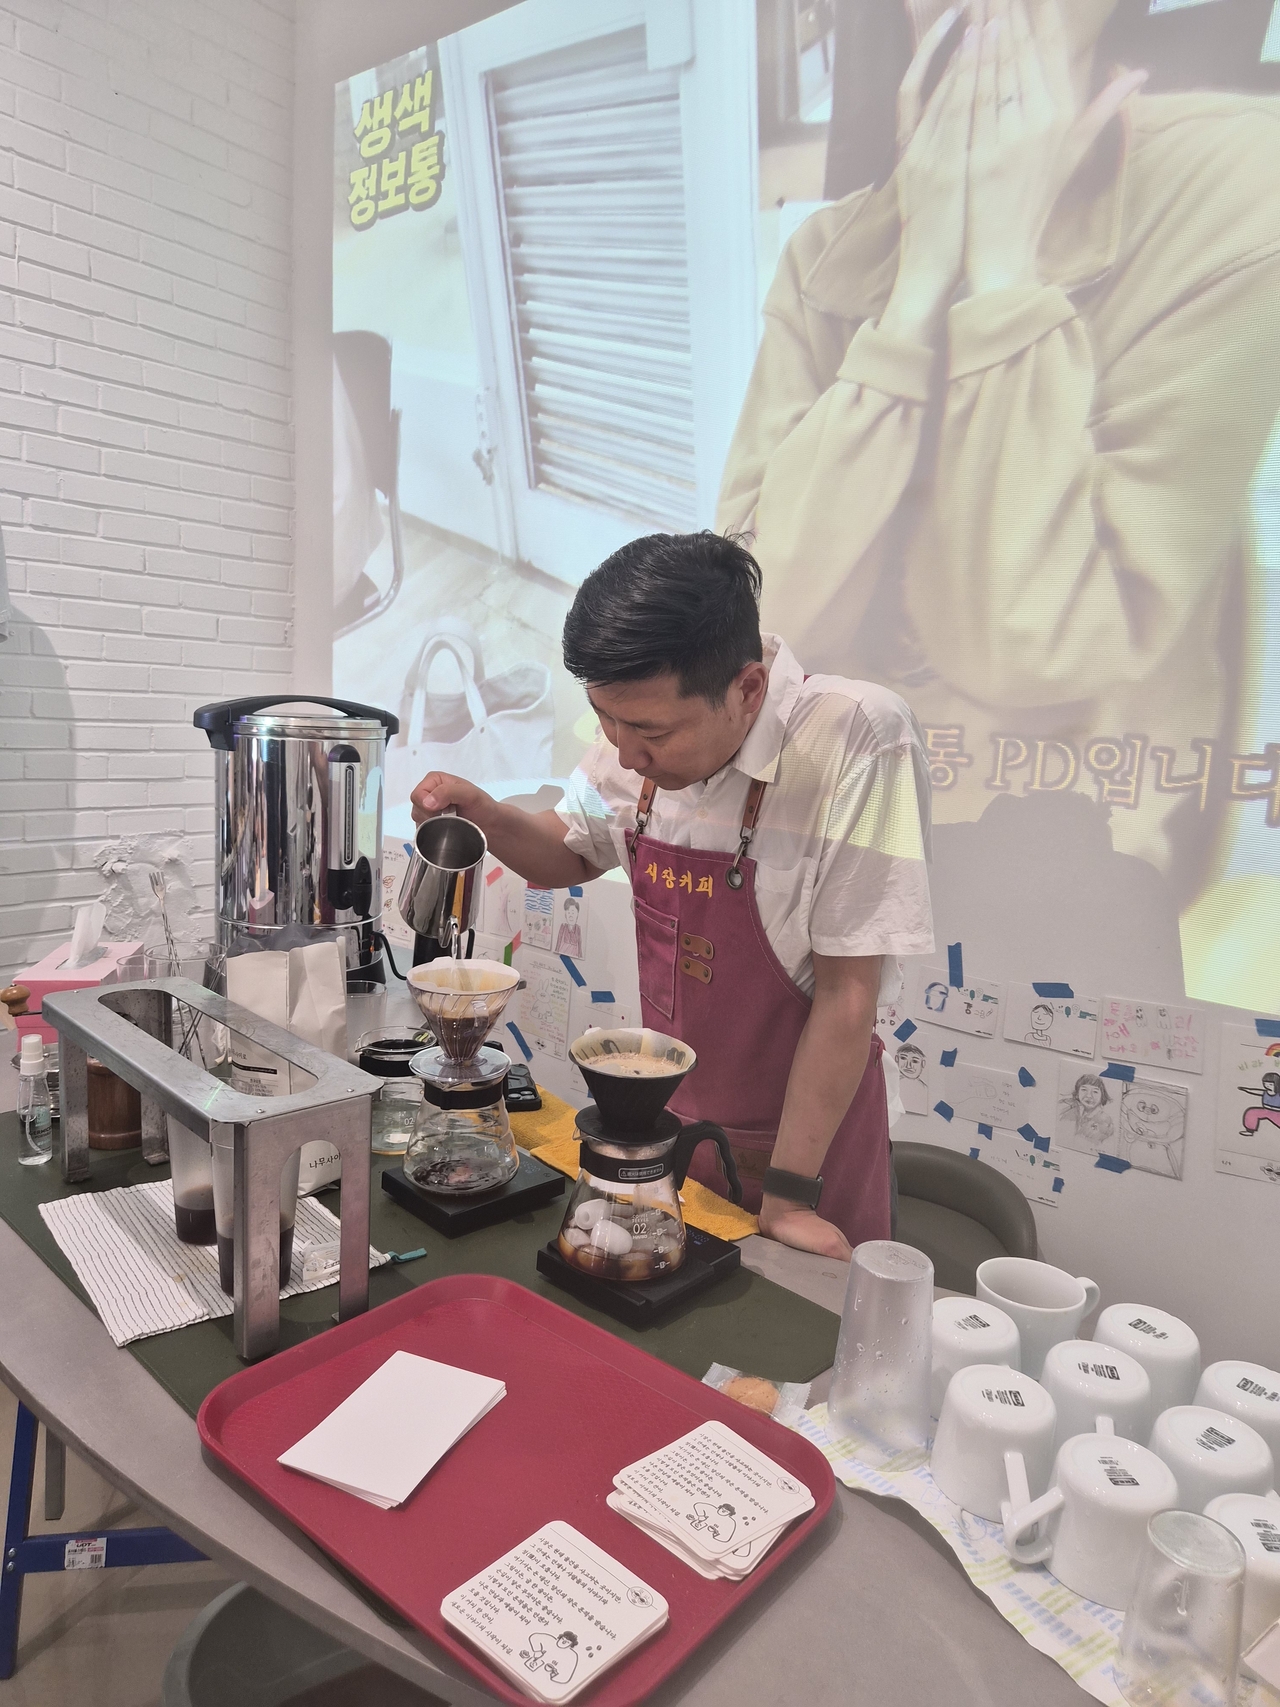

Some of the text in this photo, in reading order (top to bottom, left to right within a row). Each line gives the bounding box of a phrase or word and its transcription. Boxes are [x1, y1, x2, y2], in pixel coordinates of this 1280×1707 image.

[352, 68, 434, 160] 생색
[346, 133, 442, 227] 정보통
[644, 861, 714, 898] 시장커피
[633, 1223, 647, 1234] 02
